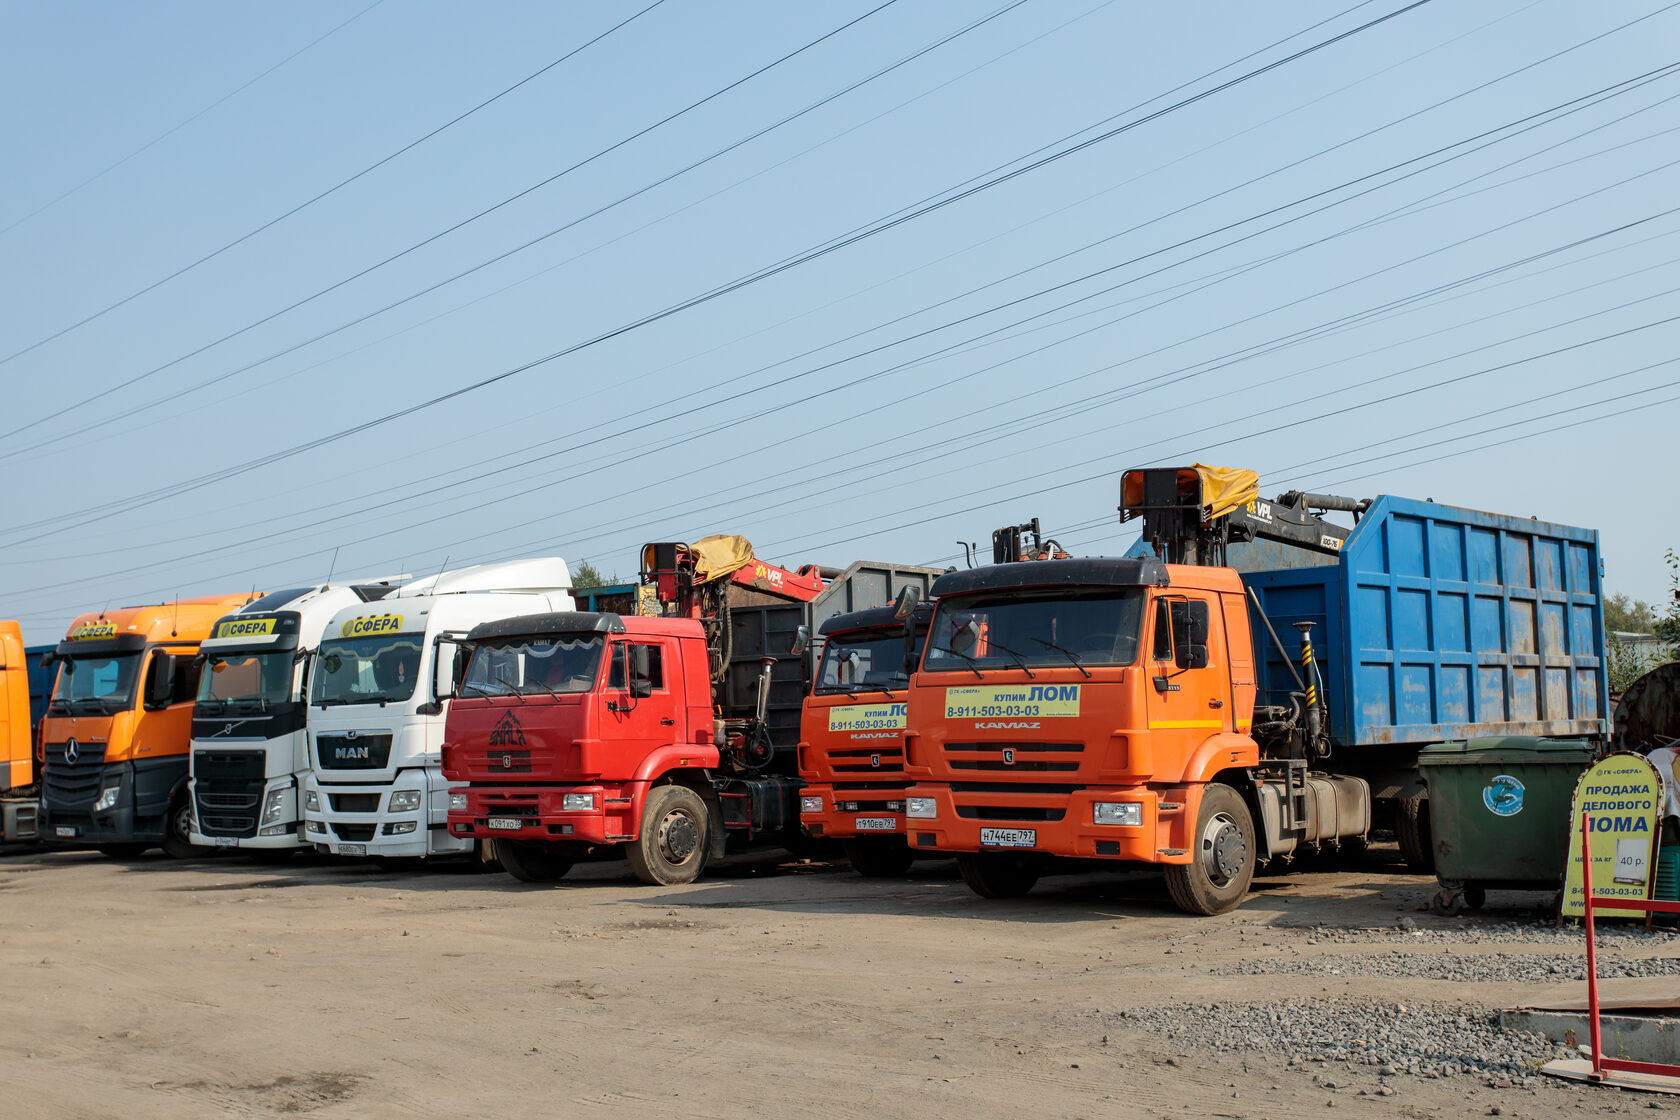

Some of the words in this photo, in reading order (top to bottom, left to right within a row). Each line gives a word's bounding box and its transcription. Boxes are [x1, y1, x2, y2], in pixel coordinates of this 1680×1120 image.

[1257, 501, 1272, 520] VPL
[767, 568, 783, 585] VPL
[230, 622, 267, 635] СФЕРА
[354, 617, 399, 633] СФЕРА
[80, 626, 114, 638] СФЕРА
[994, 693, 1026, 702] КУПИМ
[1028, 686, 1078, 701] ЛОМ
[889, 704, 907, 716] ЛО
[947, 705, 1040, 717] 8-911-503-03-03
[830, 719, 898, 730] 8-911-503-03-03
[335, 747, 369, 759] MAN
[1586, 785, 1650, 796] ПРОДАЖА
[1581, 800, 1652, 812] ДЕЛОВОГО
[983, 830, 1017, 842] Н744ЕЕ
[1018, 830, 1033, 840] 797
[1620, 856, 1633, 866] 40
[1571, 887, 1643, 896] 8-91-503-03-03
